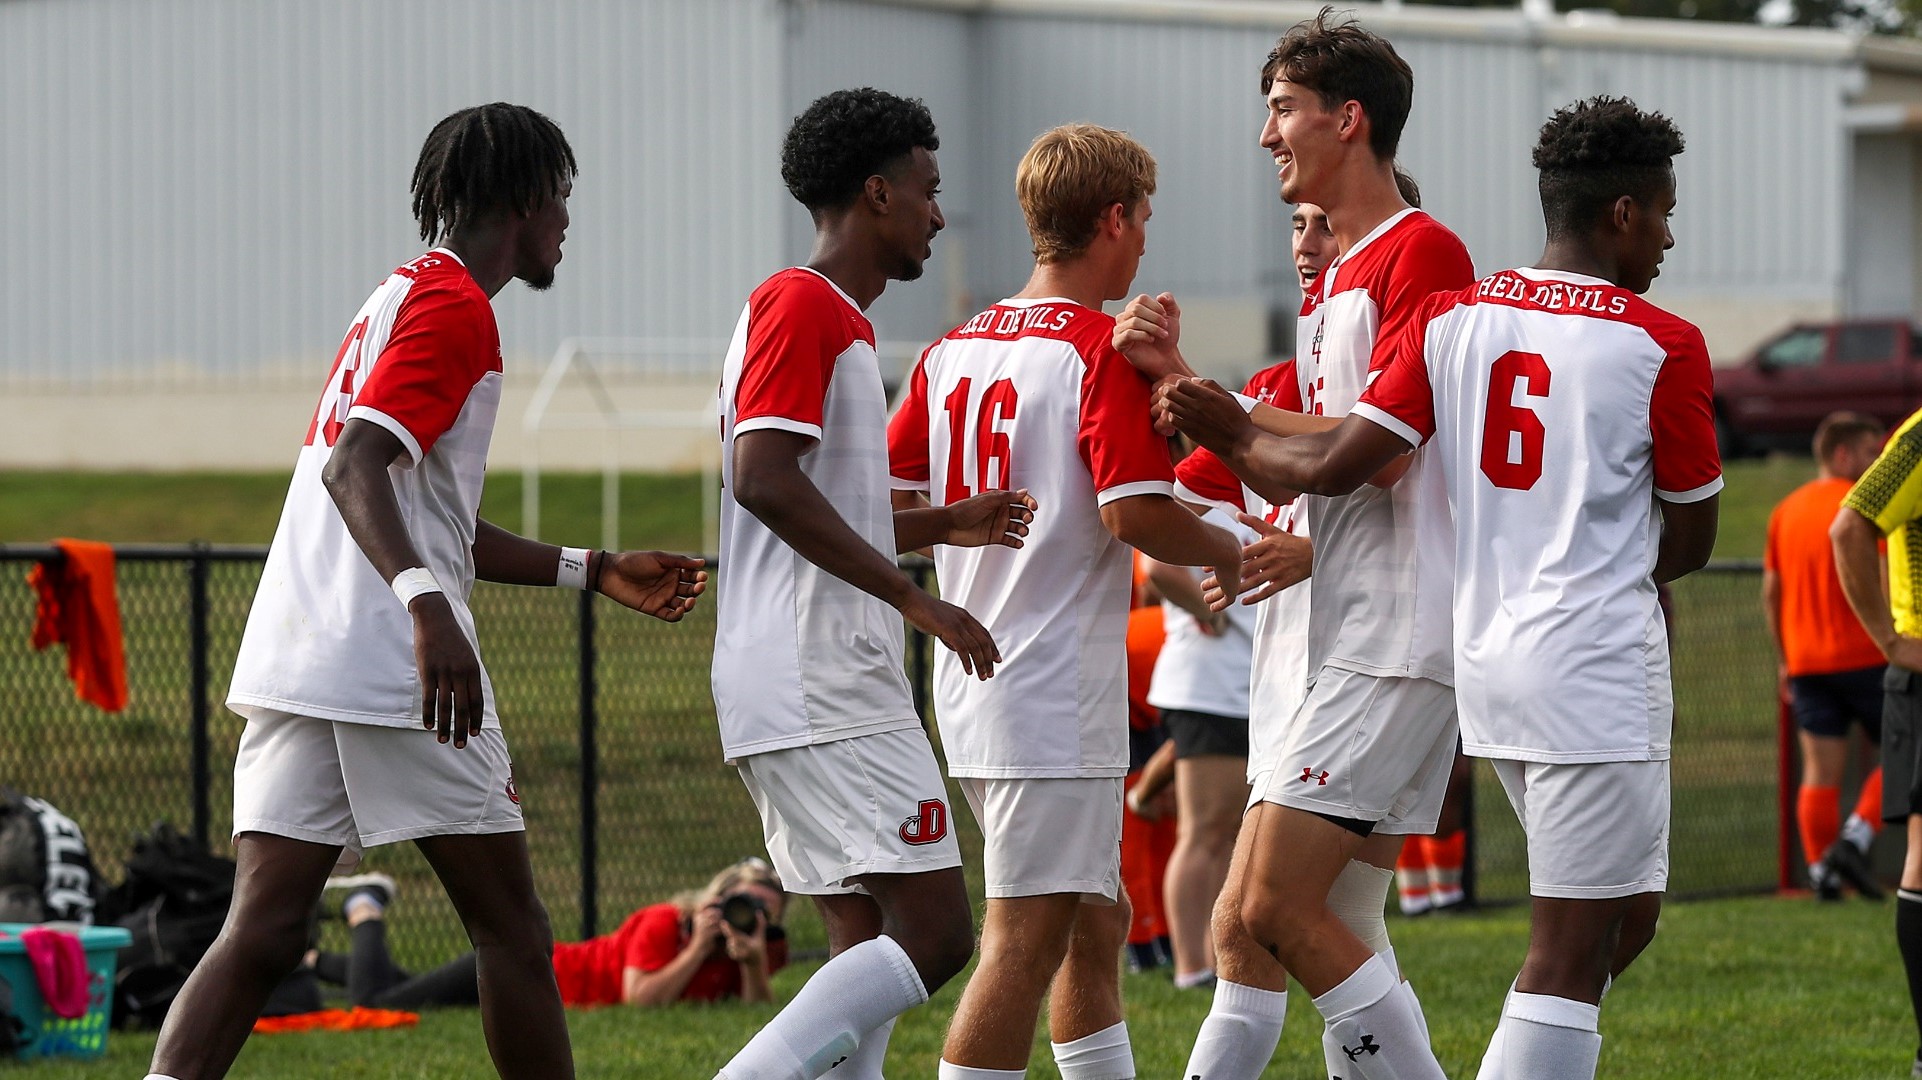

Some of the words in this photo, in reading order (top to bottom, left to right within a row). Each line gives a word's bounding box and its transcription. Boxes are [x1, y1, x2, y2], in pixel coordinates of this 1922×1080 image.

[995, 307, 1075, 335] DEVILS
[1529, 284, 1628, 315] DEVILS
[944, 377, 1018, 507] 16
[1480, 350, 1552, 491] 6
